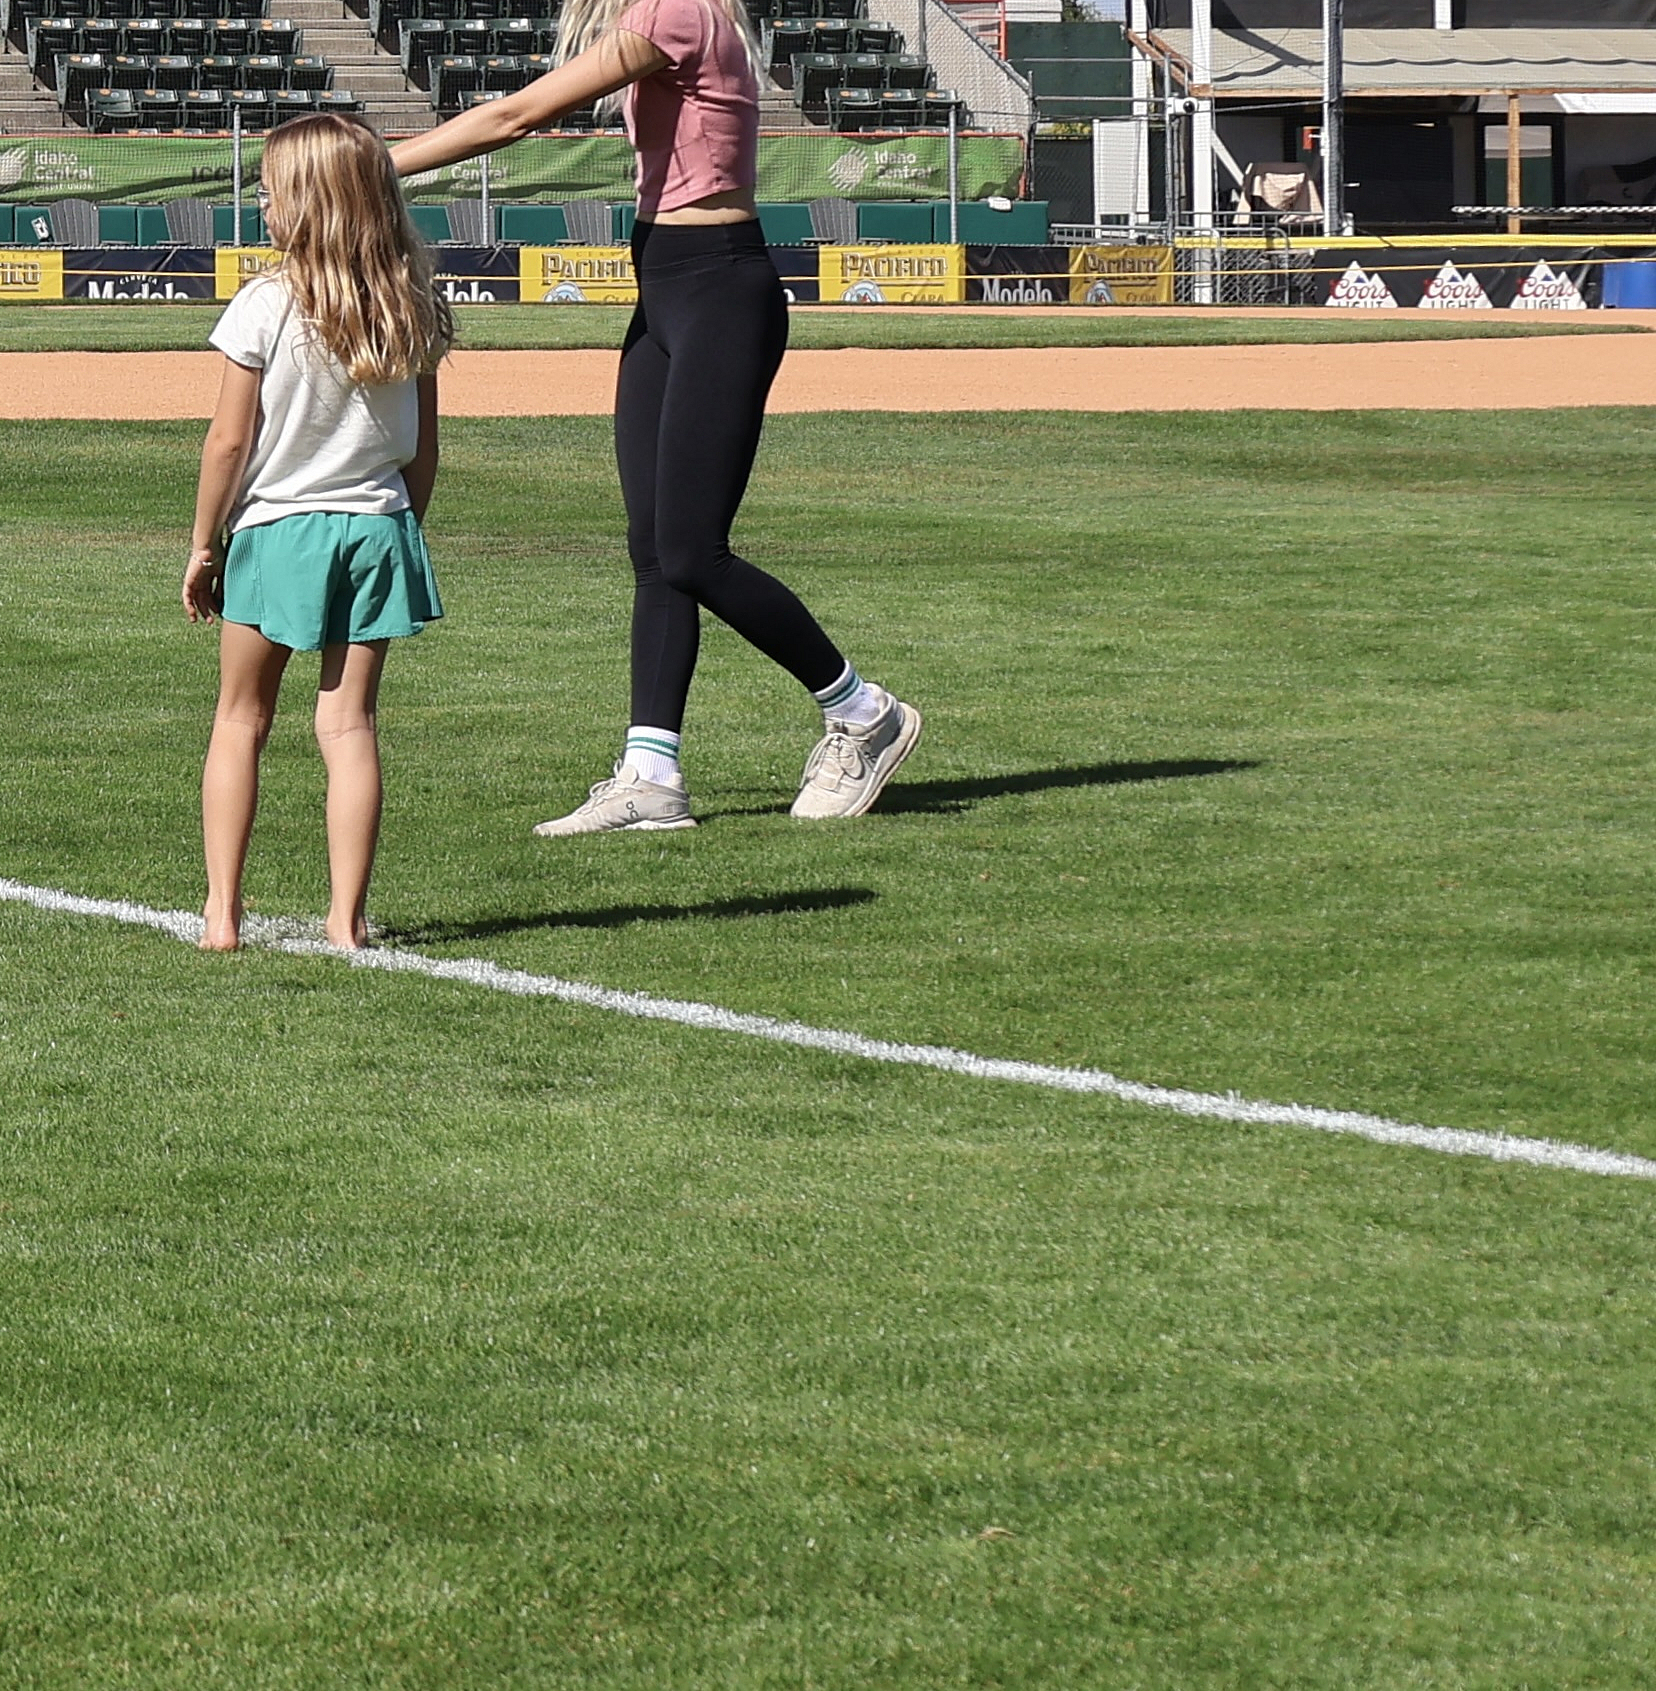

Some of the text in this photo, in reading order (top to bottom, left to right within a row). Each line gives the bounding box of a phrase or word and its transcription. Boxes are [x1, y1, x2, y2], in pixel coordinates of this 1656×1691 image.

[34, 165, 94, 181] Central
[982, 279, 1053, 304] Modelo
[1329, 278, 1391, 299] Coors
[1424, 278, 1483, 299] Coors
[1517, 277, 1577, 298] Coors
